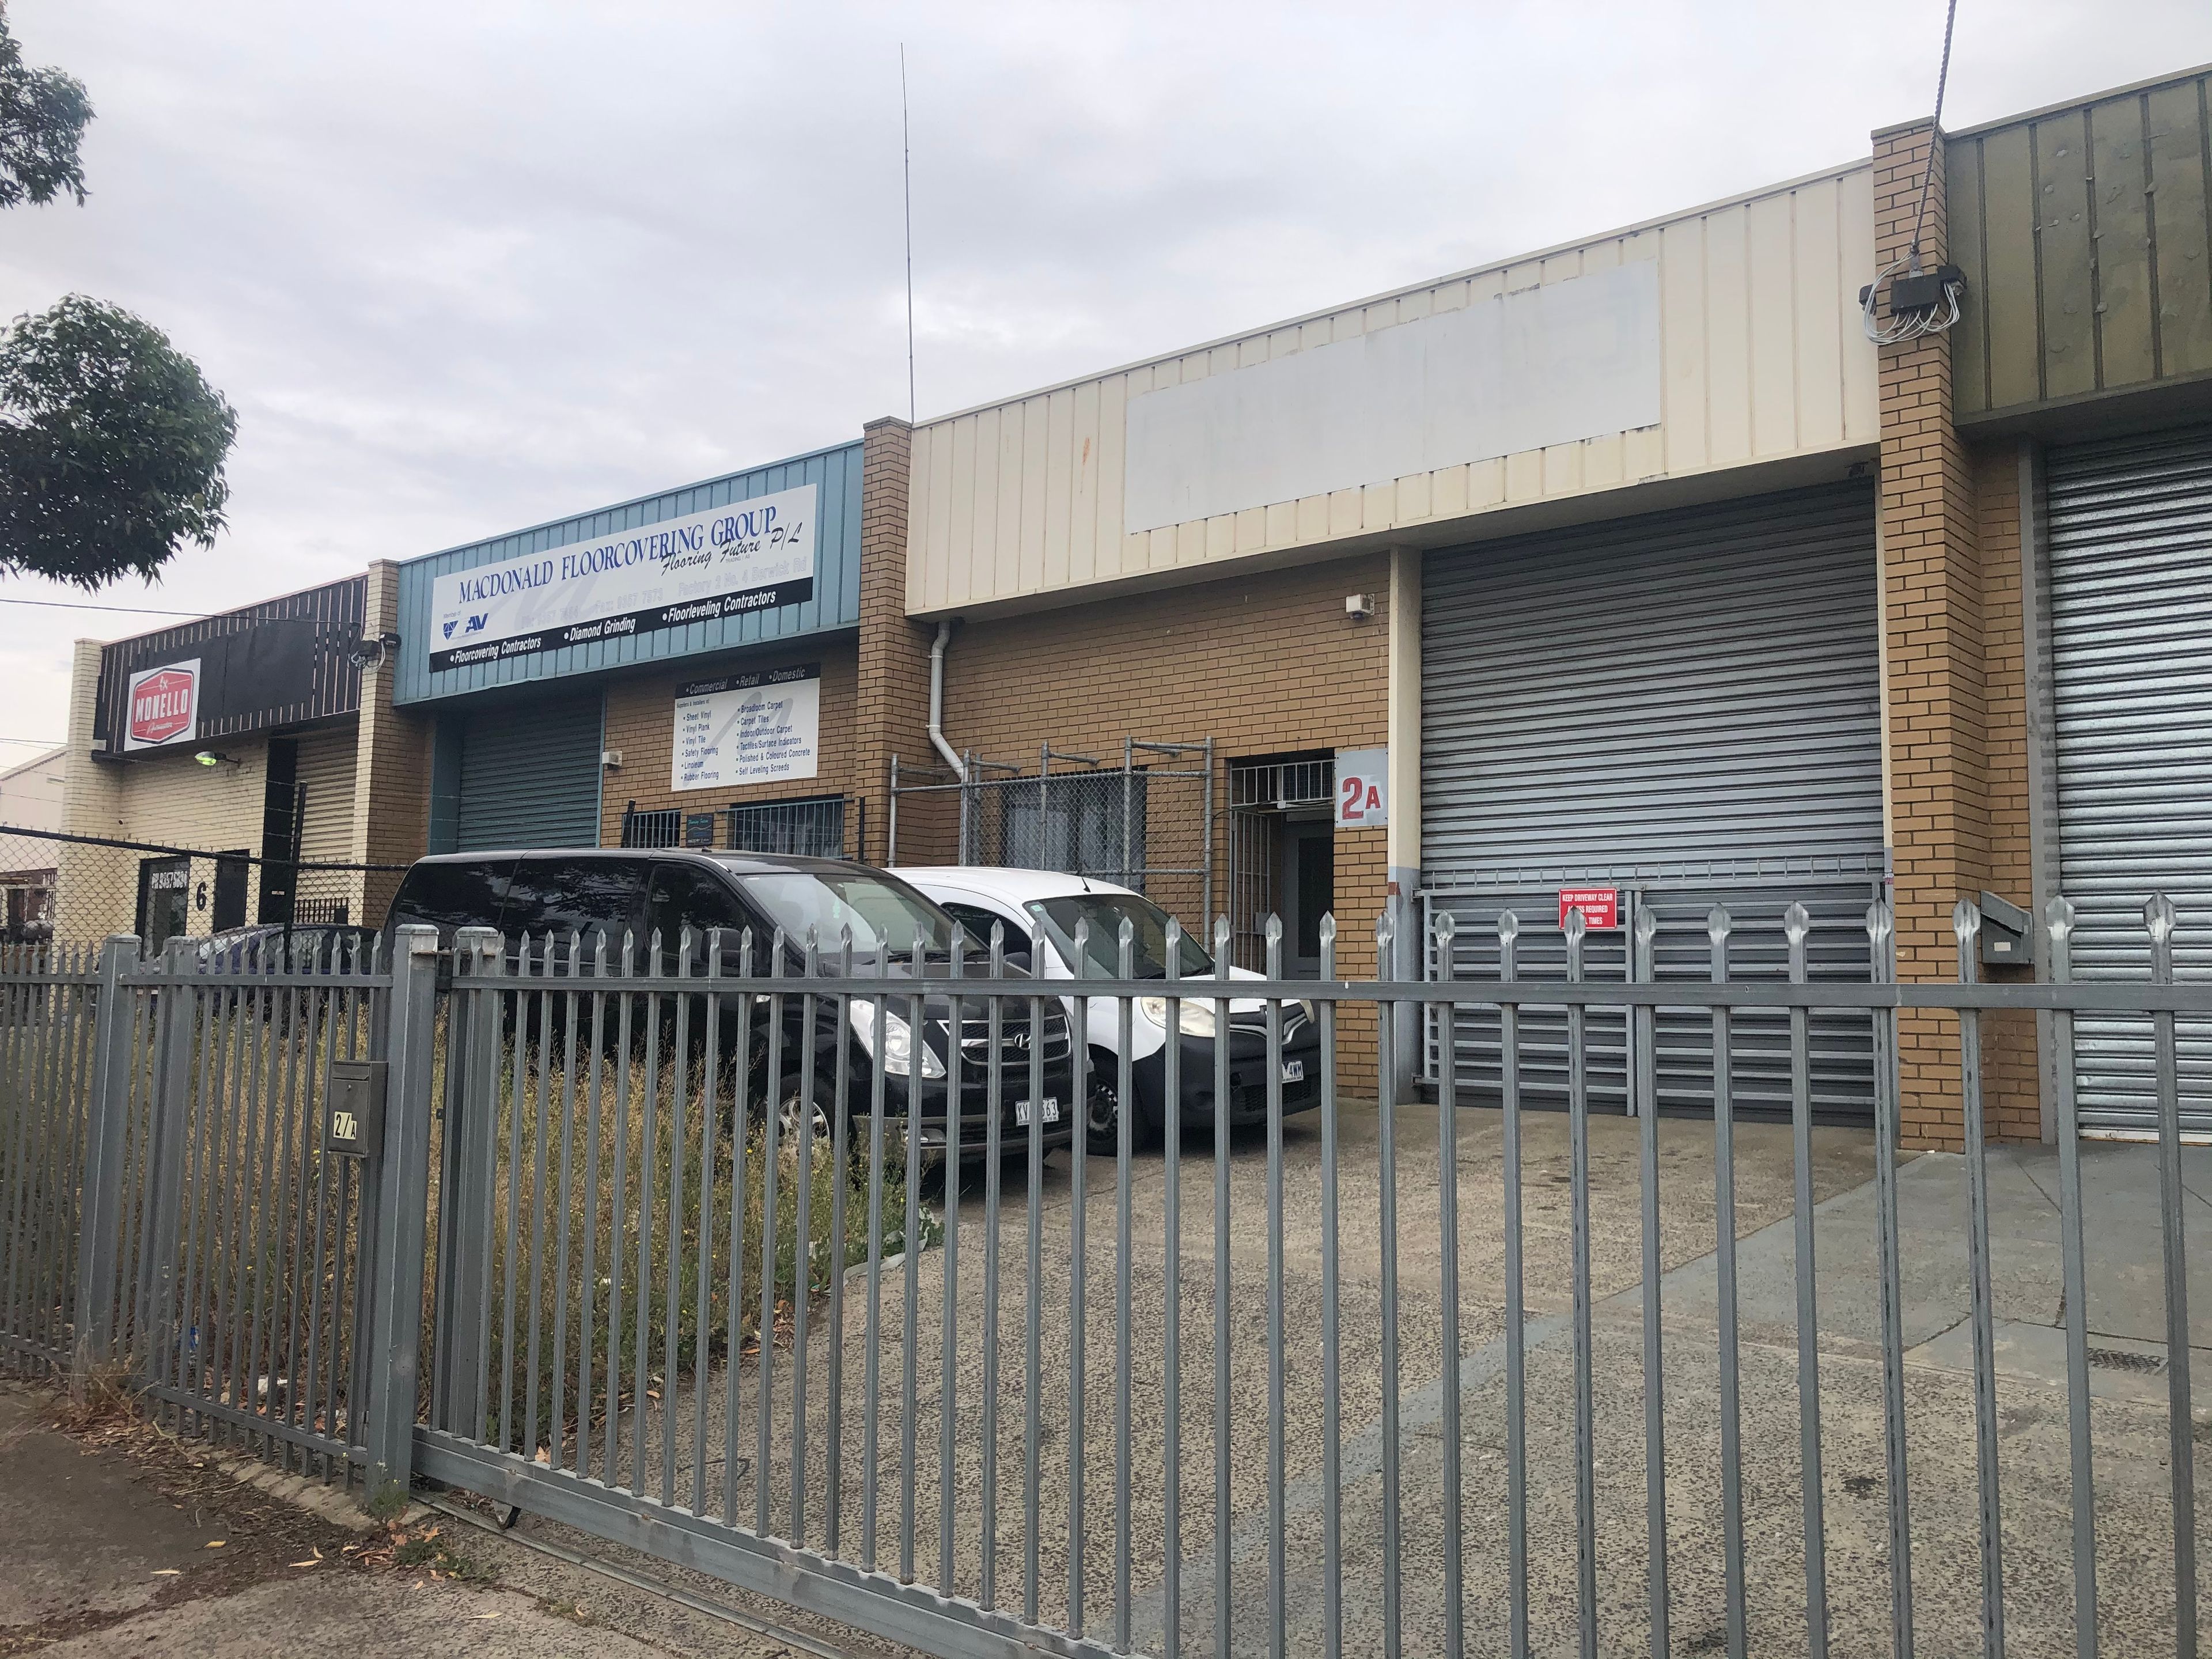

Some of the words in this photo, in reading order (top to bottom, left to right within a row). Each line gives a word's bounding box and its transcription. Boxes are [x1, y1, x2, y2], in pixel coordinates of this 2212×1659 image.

[459, 560, 554, 604] MACDONALD
[562, 524, 704, 581] FLOORCOVERING
[711, 506, 777, 546] GROUP
[661, 551, 713, 577] Flooring
[719, 539, 761, 563] Future
[770, 522, 803, 550] P/L
[668, 600, 721, 623] Floorleveling
[724, 590, 777, 612] Contractors
[570, 622, 602, 642] Diamond
[604, 618, 636, 634] Grinding
[455, 645, 498, 664] Floorcovering
[501, 637, 541, 654] Contractors
[740, 673, 760, 687] Retail
[772, 666, 806, 682] Domestic
[690, 678, 728, 694] Commercial
[135, 688, 188, 723] MONELLO
[741, 703, 765, 713] Broadloom
[767, 700, 783, 711] Carpet
[687, 713, 699, 721] Sheet
[700, 710, 711, 720] Vinyl
[741, 717, 756, 726] Carpet
[758, 715, 769, 723] Tiles
[686, 724, 696, 734] Vinyl
[698, 723, 710, 731] Plank
[777, 725, 793, 734] Carpet
[686, 736, 696, 746] Vinyl
[698, 735, 706, 744] Tile
[778, 737, 801, 747] Indicators
[685, 748, 699, 758] Safety
[700, 747, 719, 756] Flooring
[740, 753, 759, 763] Polished
[760, 752, 763, 760] &
[766, 750, 787, 760] Coloured
[789, 748, 810, 757] Concrete
[684, 760, 704, 769] Linoleum
[739, 767, 748, 775] Self
[750, 765, 768, 775] Leveling
[771, 763, 789, 772] Screeds
[684, 772, 699, 781] Rubber
[701, 771, 719, 780] Flooring
[1342, 777, 1381, 820] 2A
[196, 882, 206, 911] 6
[1574, 893, 1597, 902] DRIVEWAY
[1598, 893, 1613, 901] CLEAR
[1586, 905, 1608, 913] REQUIRED
[1588, 916, 1603, 925] TIMES
[335, 1113, 355, 1138] 2/A
